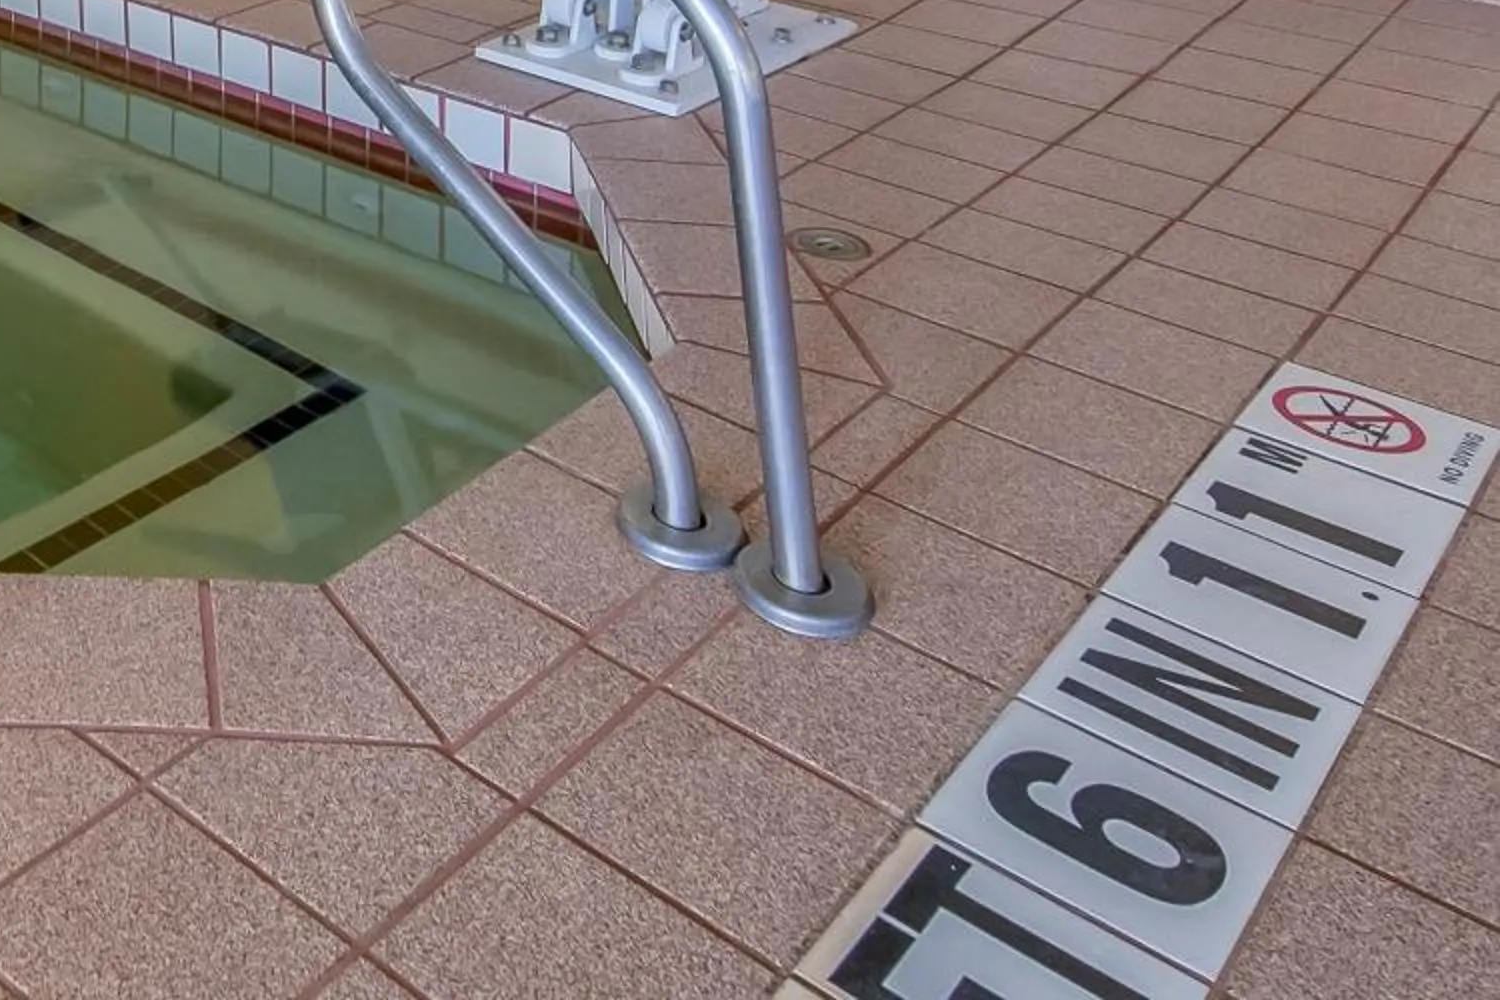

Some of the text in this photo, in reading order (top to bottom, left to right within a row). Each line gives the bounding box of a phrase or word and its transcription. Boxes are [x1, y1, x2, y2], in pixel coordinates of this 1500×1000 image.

[1238, 437, 1309, 474] M
[1438, 431, 1485, 485] NO DIVING
[1158, 480, 1405, 640] 1.1
[1057, 617, 1321, 792] IN
[986, 750, 1228, 907] 6
